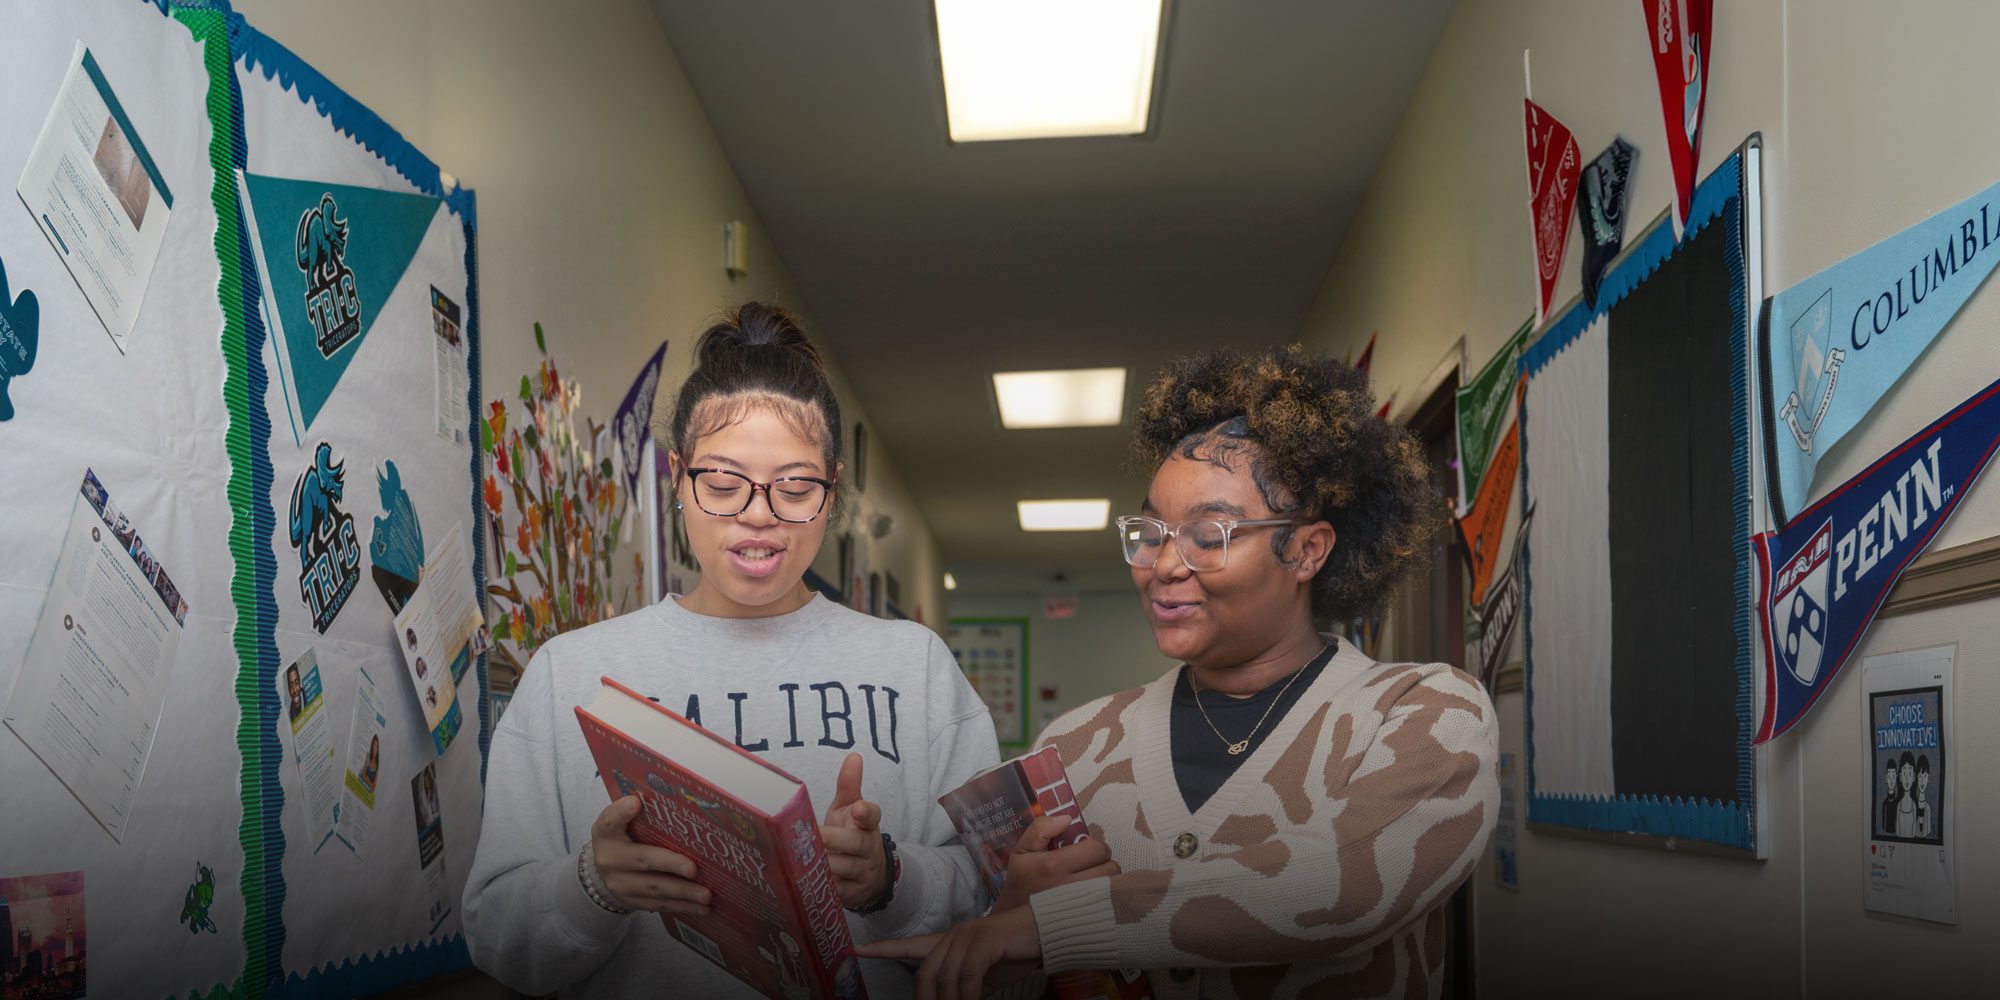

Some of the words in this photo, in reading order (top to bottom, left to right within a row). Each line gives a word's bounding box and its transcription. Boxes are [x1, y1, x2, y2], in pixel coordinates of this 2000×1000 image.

[324, 321, 357, 351] TRICERATOPS
[1834, 437, 1942, 602] PENN
[1942, 484, 1954, 502] TM
[320, 572, 359, 626] TRICERATOPS
[1482, 576, 1519, 669] BROWN
[647, 681, 900, 763] ALIBU
[1878, 726, 1937, 748] INNOVATIVE!
[1889, 703, 1924, 725] CHOOSE
[638, 790, 766, 880] HISTORY
[647, 813, 776, 897] ENCYCLOPEDIA
[654, 789, 680, 811] THE
[684, 809, 762, 860] KINGFISHER
[796, 875, 835, 969] ENCYCLOPEDIA
[808, 857, 849, 959] HISTORY
